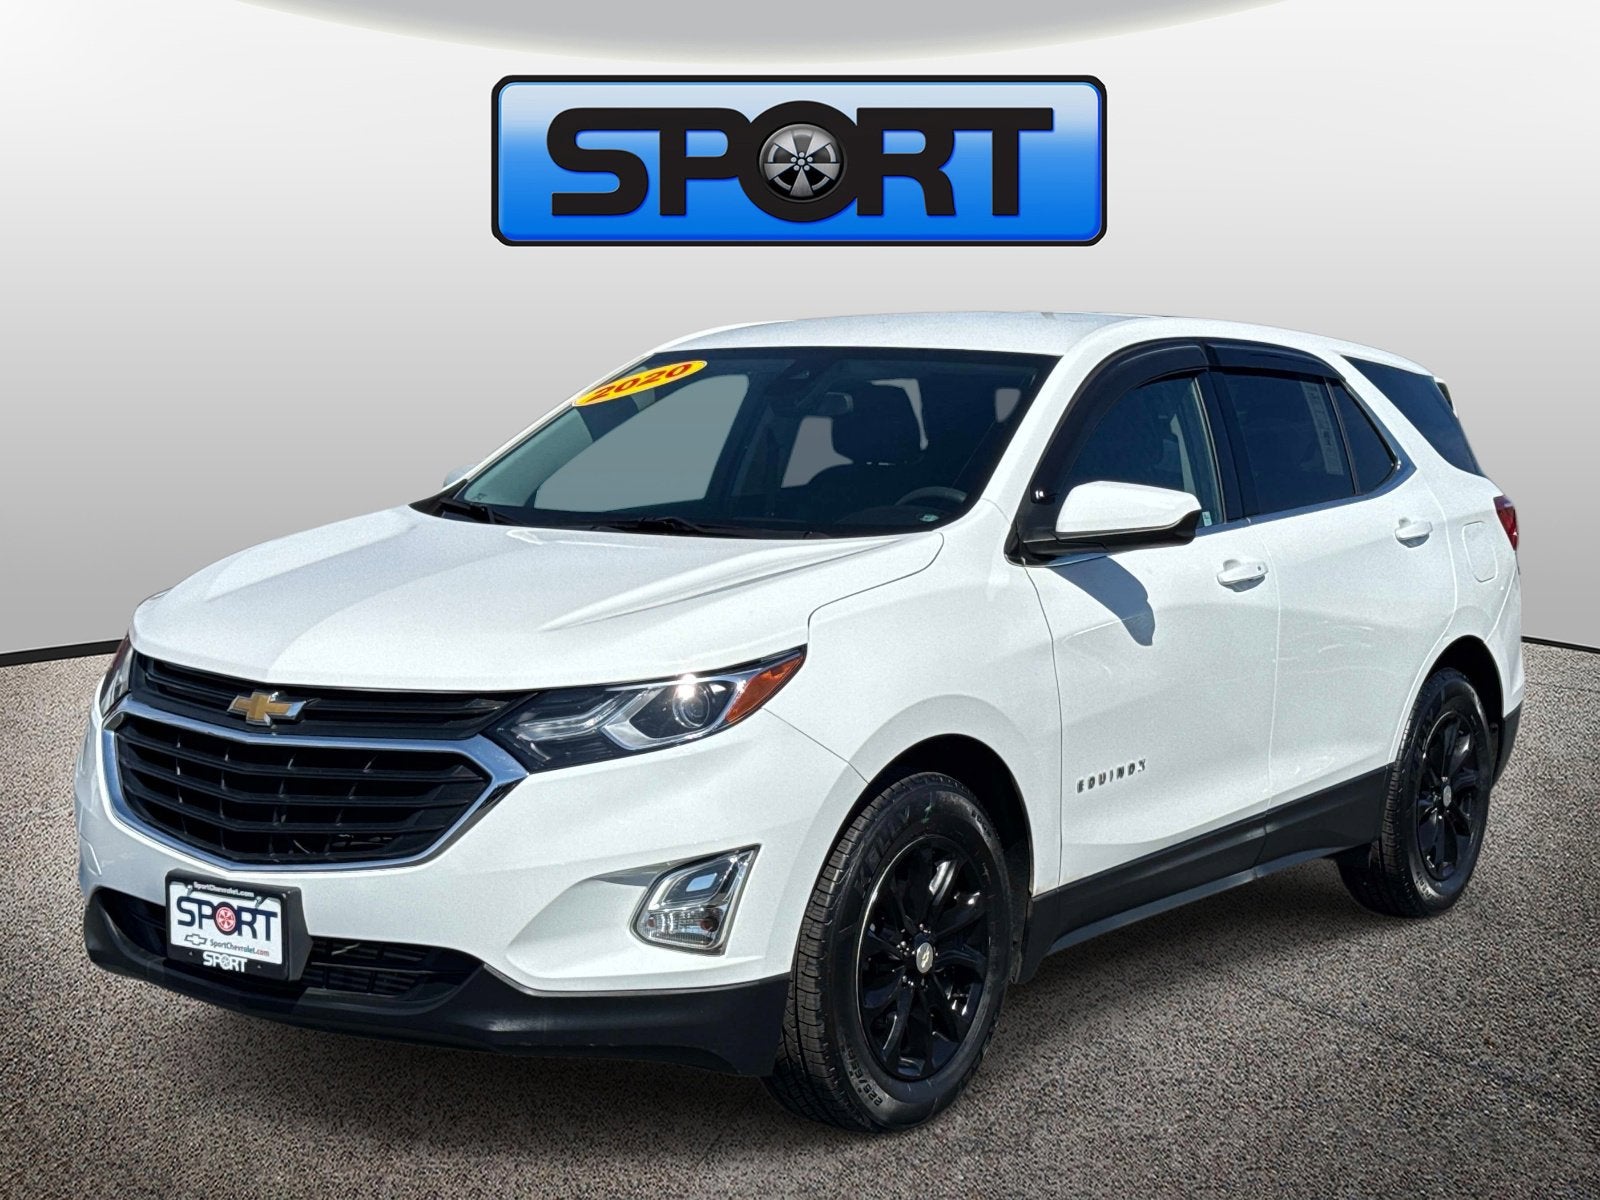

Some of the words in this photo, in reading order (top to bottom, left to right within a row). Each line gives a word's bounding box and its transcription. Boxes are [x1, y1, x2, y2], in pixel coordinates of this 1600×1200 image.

[583, 363, 692, 402] 2020
[1077, 758, 1146, 793] EQUINOX
[193, 881, 254, 897] SportChevrolet.com
[176, 896, 278, 942] SPORT
[209, 938, 270, 957] SportChevrolet.com
[202, 951, 249, 973] SPORT
